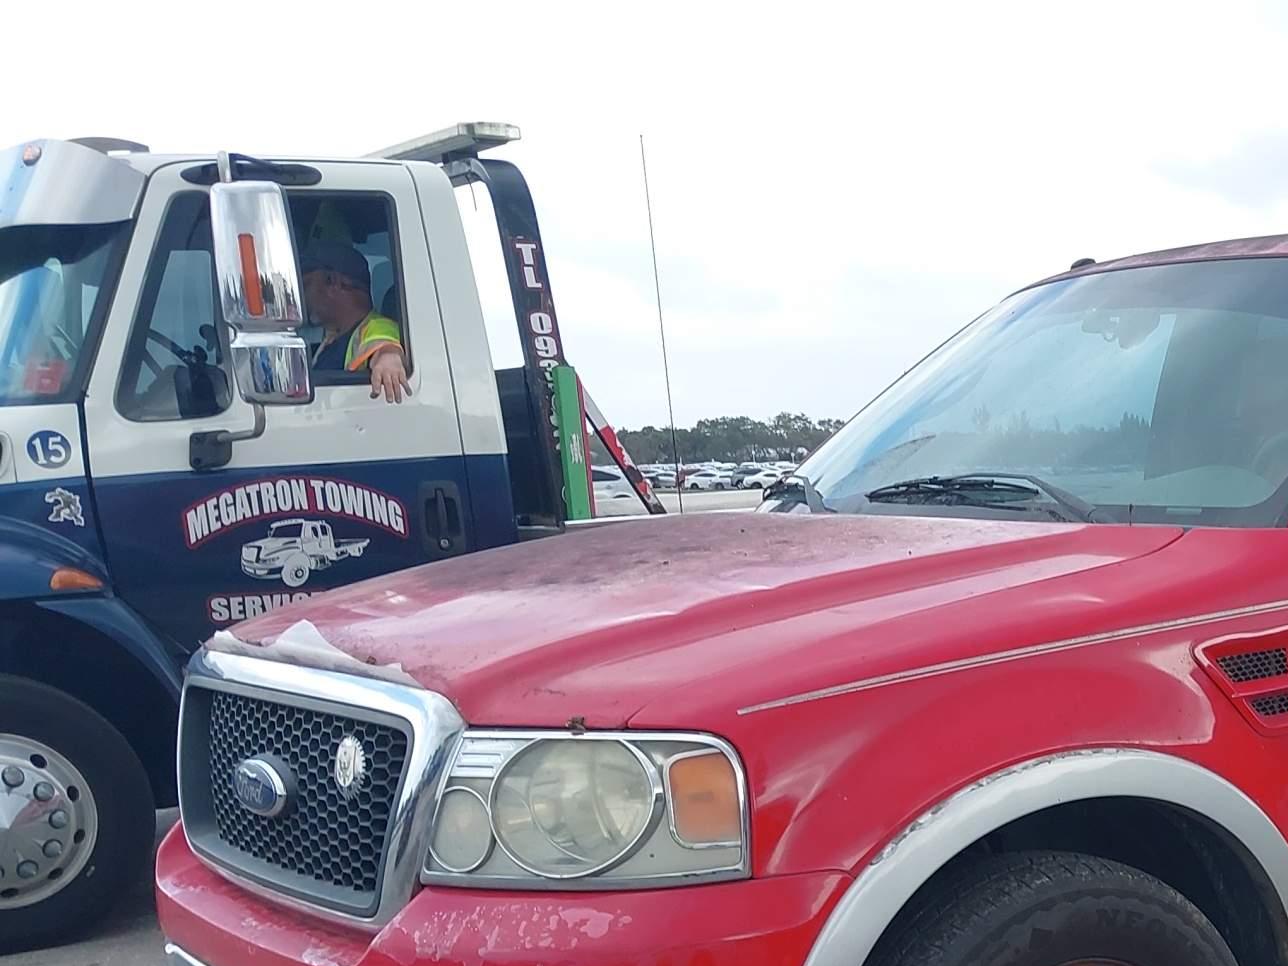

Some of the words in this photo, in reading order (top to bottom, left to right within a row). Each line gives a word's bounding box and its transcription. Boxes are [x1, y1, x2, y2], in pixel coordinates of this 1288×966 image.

[516, 243, 543, 288] TL
[32, 436, 65, 465] 15
[186, 479, 308, 545] MEGATRON
[310, 480, 405, 534] TOWING
[210, 591, 325, 622] SERVI
